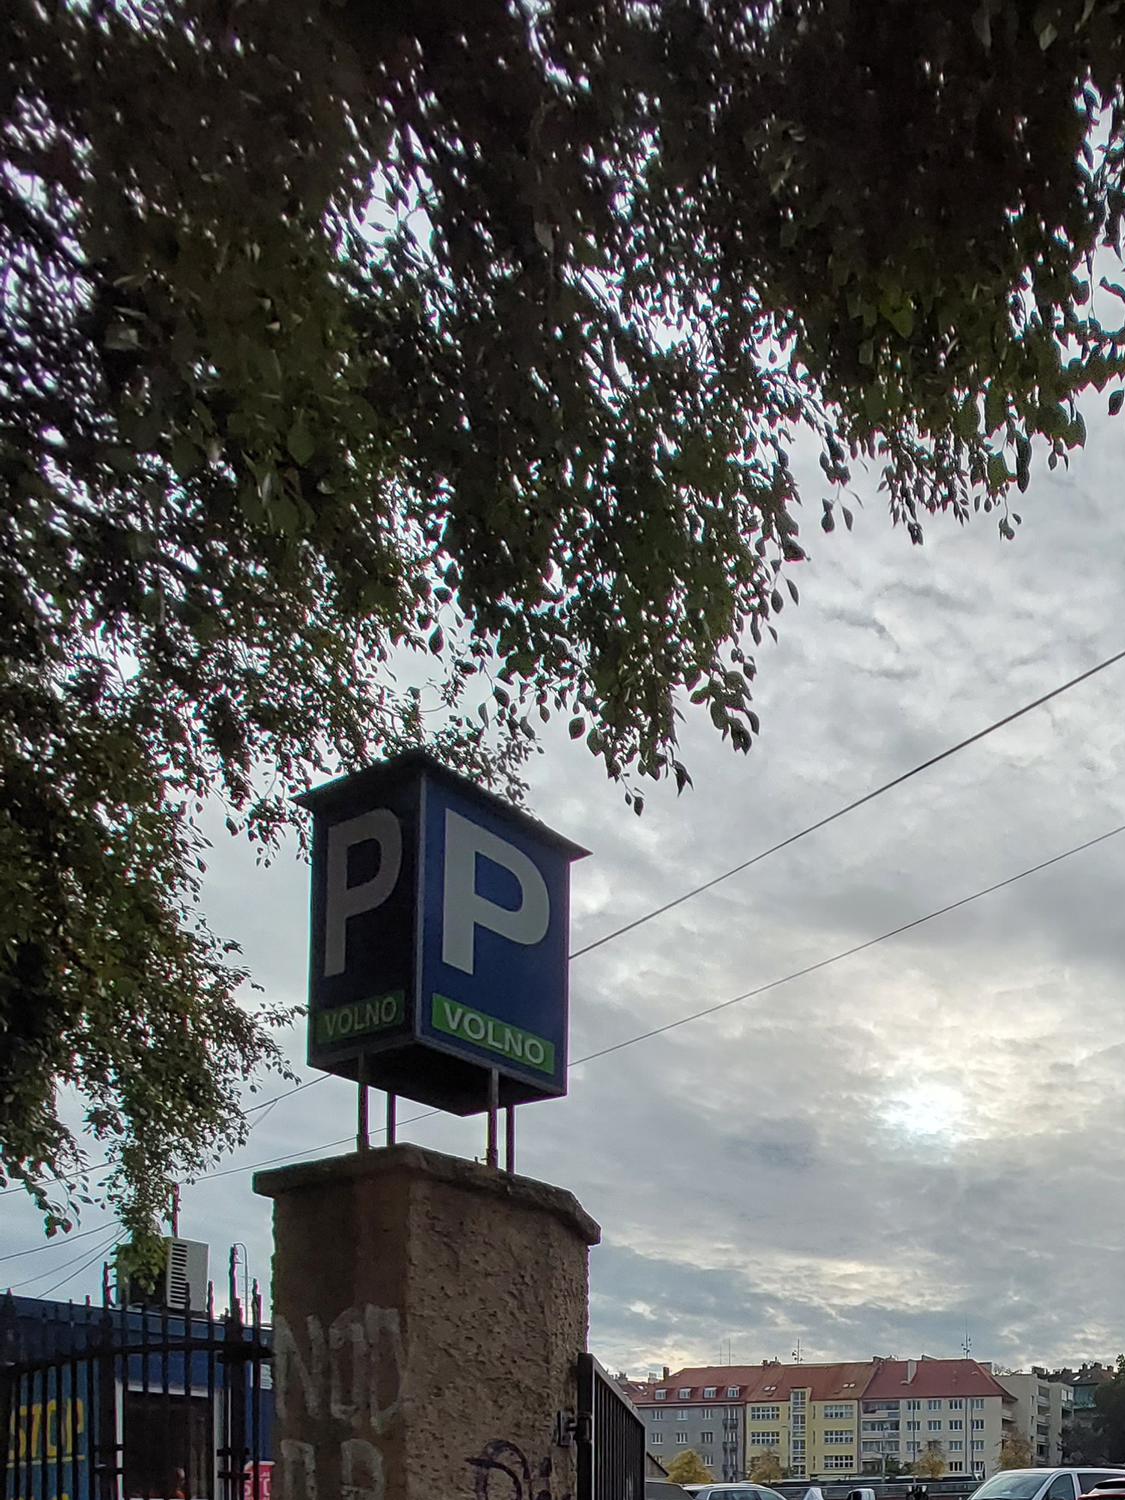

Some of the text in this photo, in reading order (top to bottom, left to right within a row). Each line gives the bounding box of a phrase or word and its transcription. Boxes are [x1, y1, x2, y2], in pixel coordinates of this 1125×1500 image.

[324, 808, 402, 977] P
[442, 808, 550, 976] P
[323, 996, 397, 1037] VOLNO
[444, 1002, 544, 1064] VOLNO
